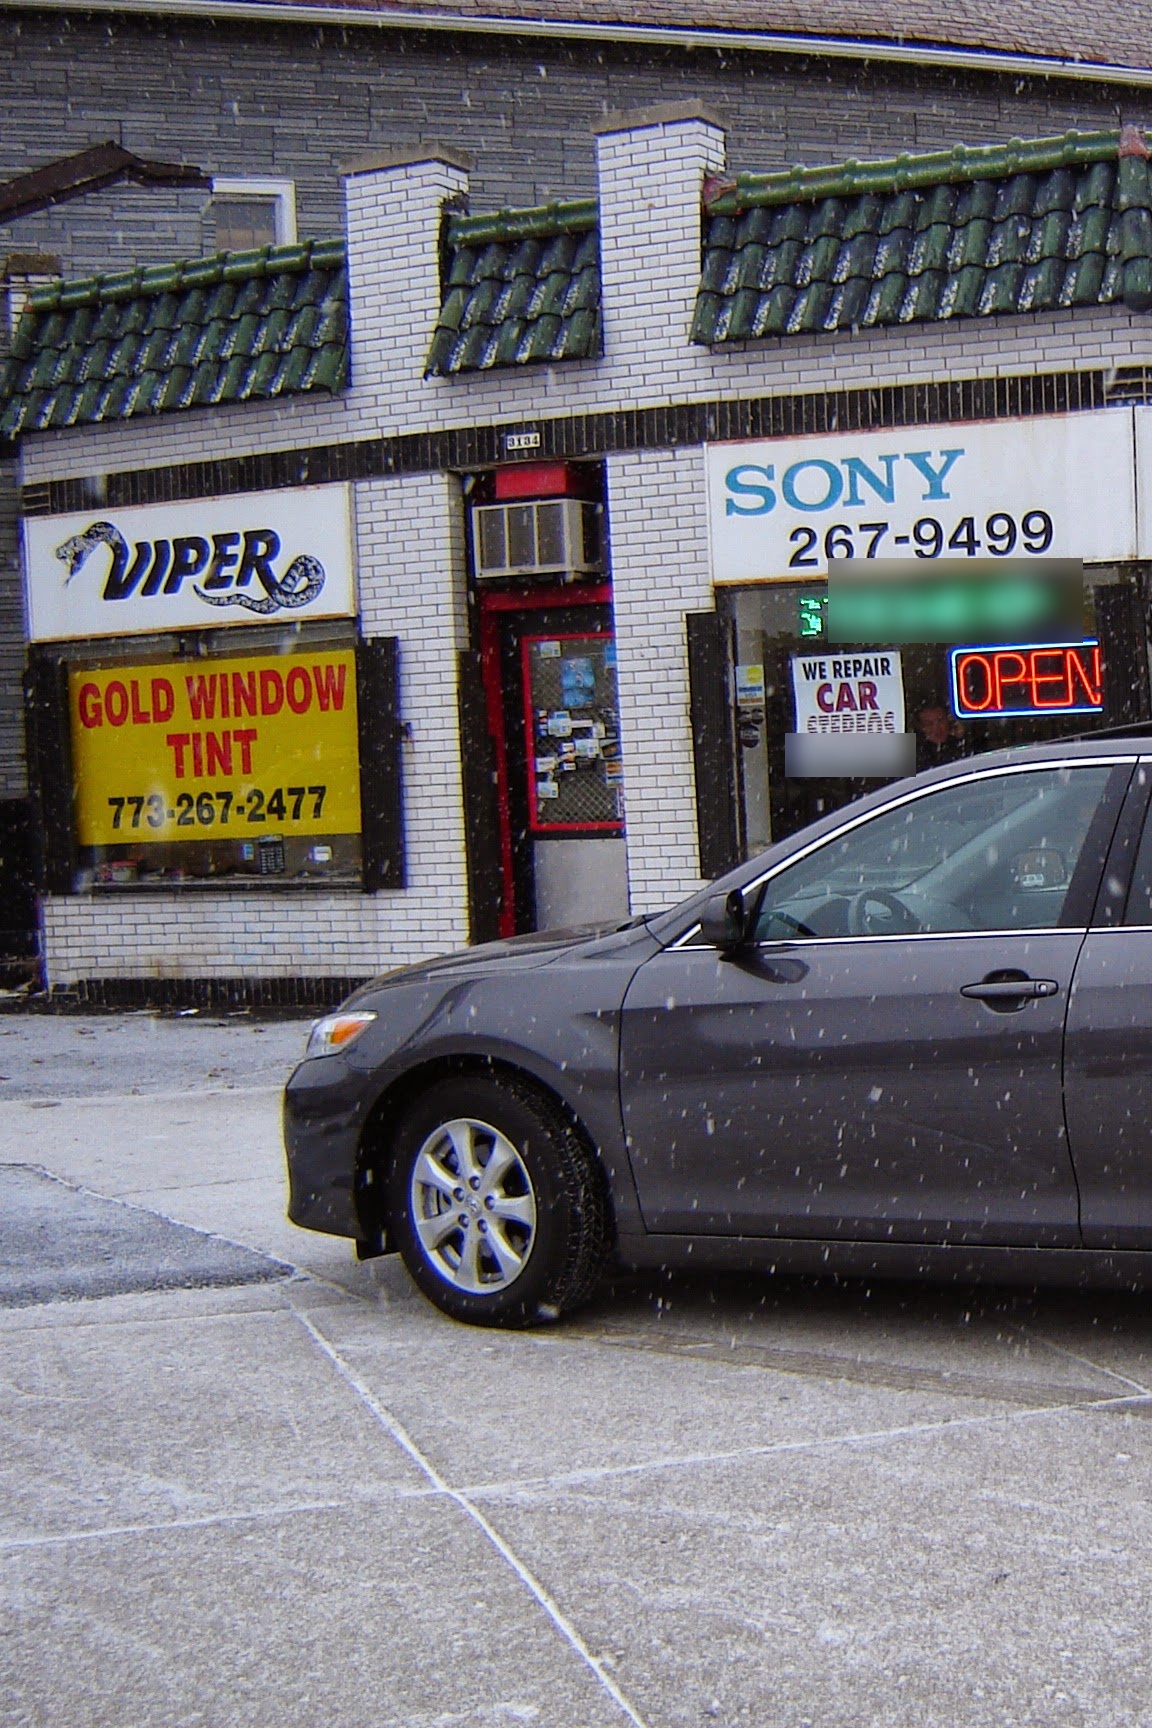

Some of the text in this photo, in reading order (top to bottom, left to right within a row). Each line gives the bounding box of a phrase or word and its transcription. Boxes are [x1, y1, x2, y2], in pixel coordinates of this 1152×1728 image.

[508, 434, 539, 447] 3134
[724, 448, 966, 517] SONY
[788, 509, 1055, 568] 267-9499
[101, 521, 326, 614] VIPER
[79, 664, 347, 729] GOLD WINDOW
[802, 657, 892, 681] WE REPAIR
[816, 680, 880, 713] CAR
[958, 647, 1103, 711] OPEN
[166, 728, 258, 779] TINT
[108, 785, 327, 829] 773-267-2477
